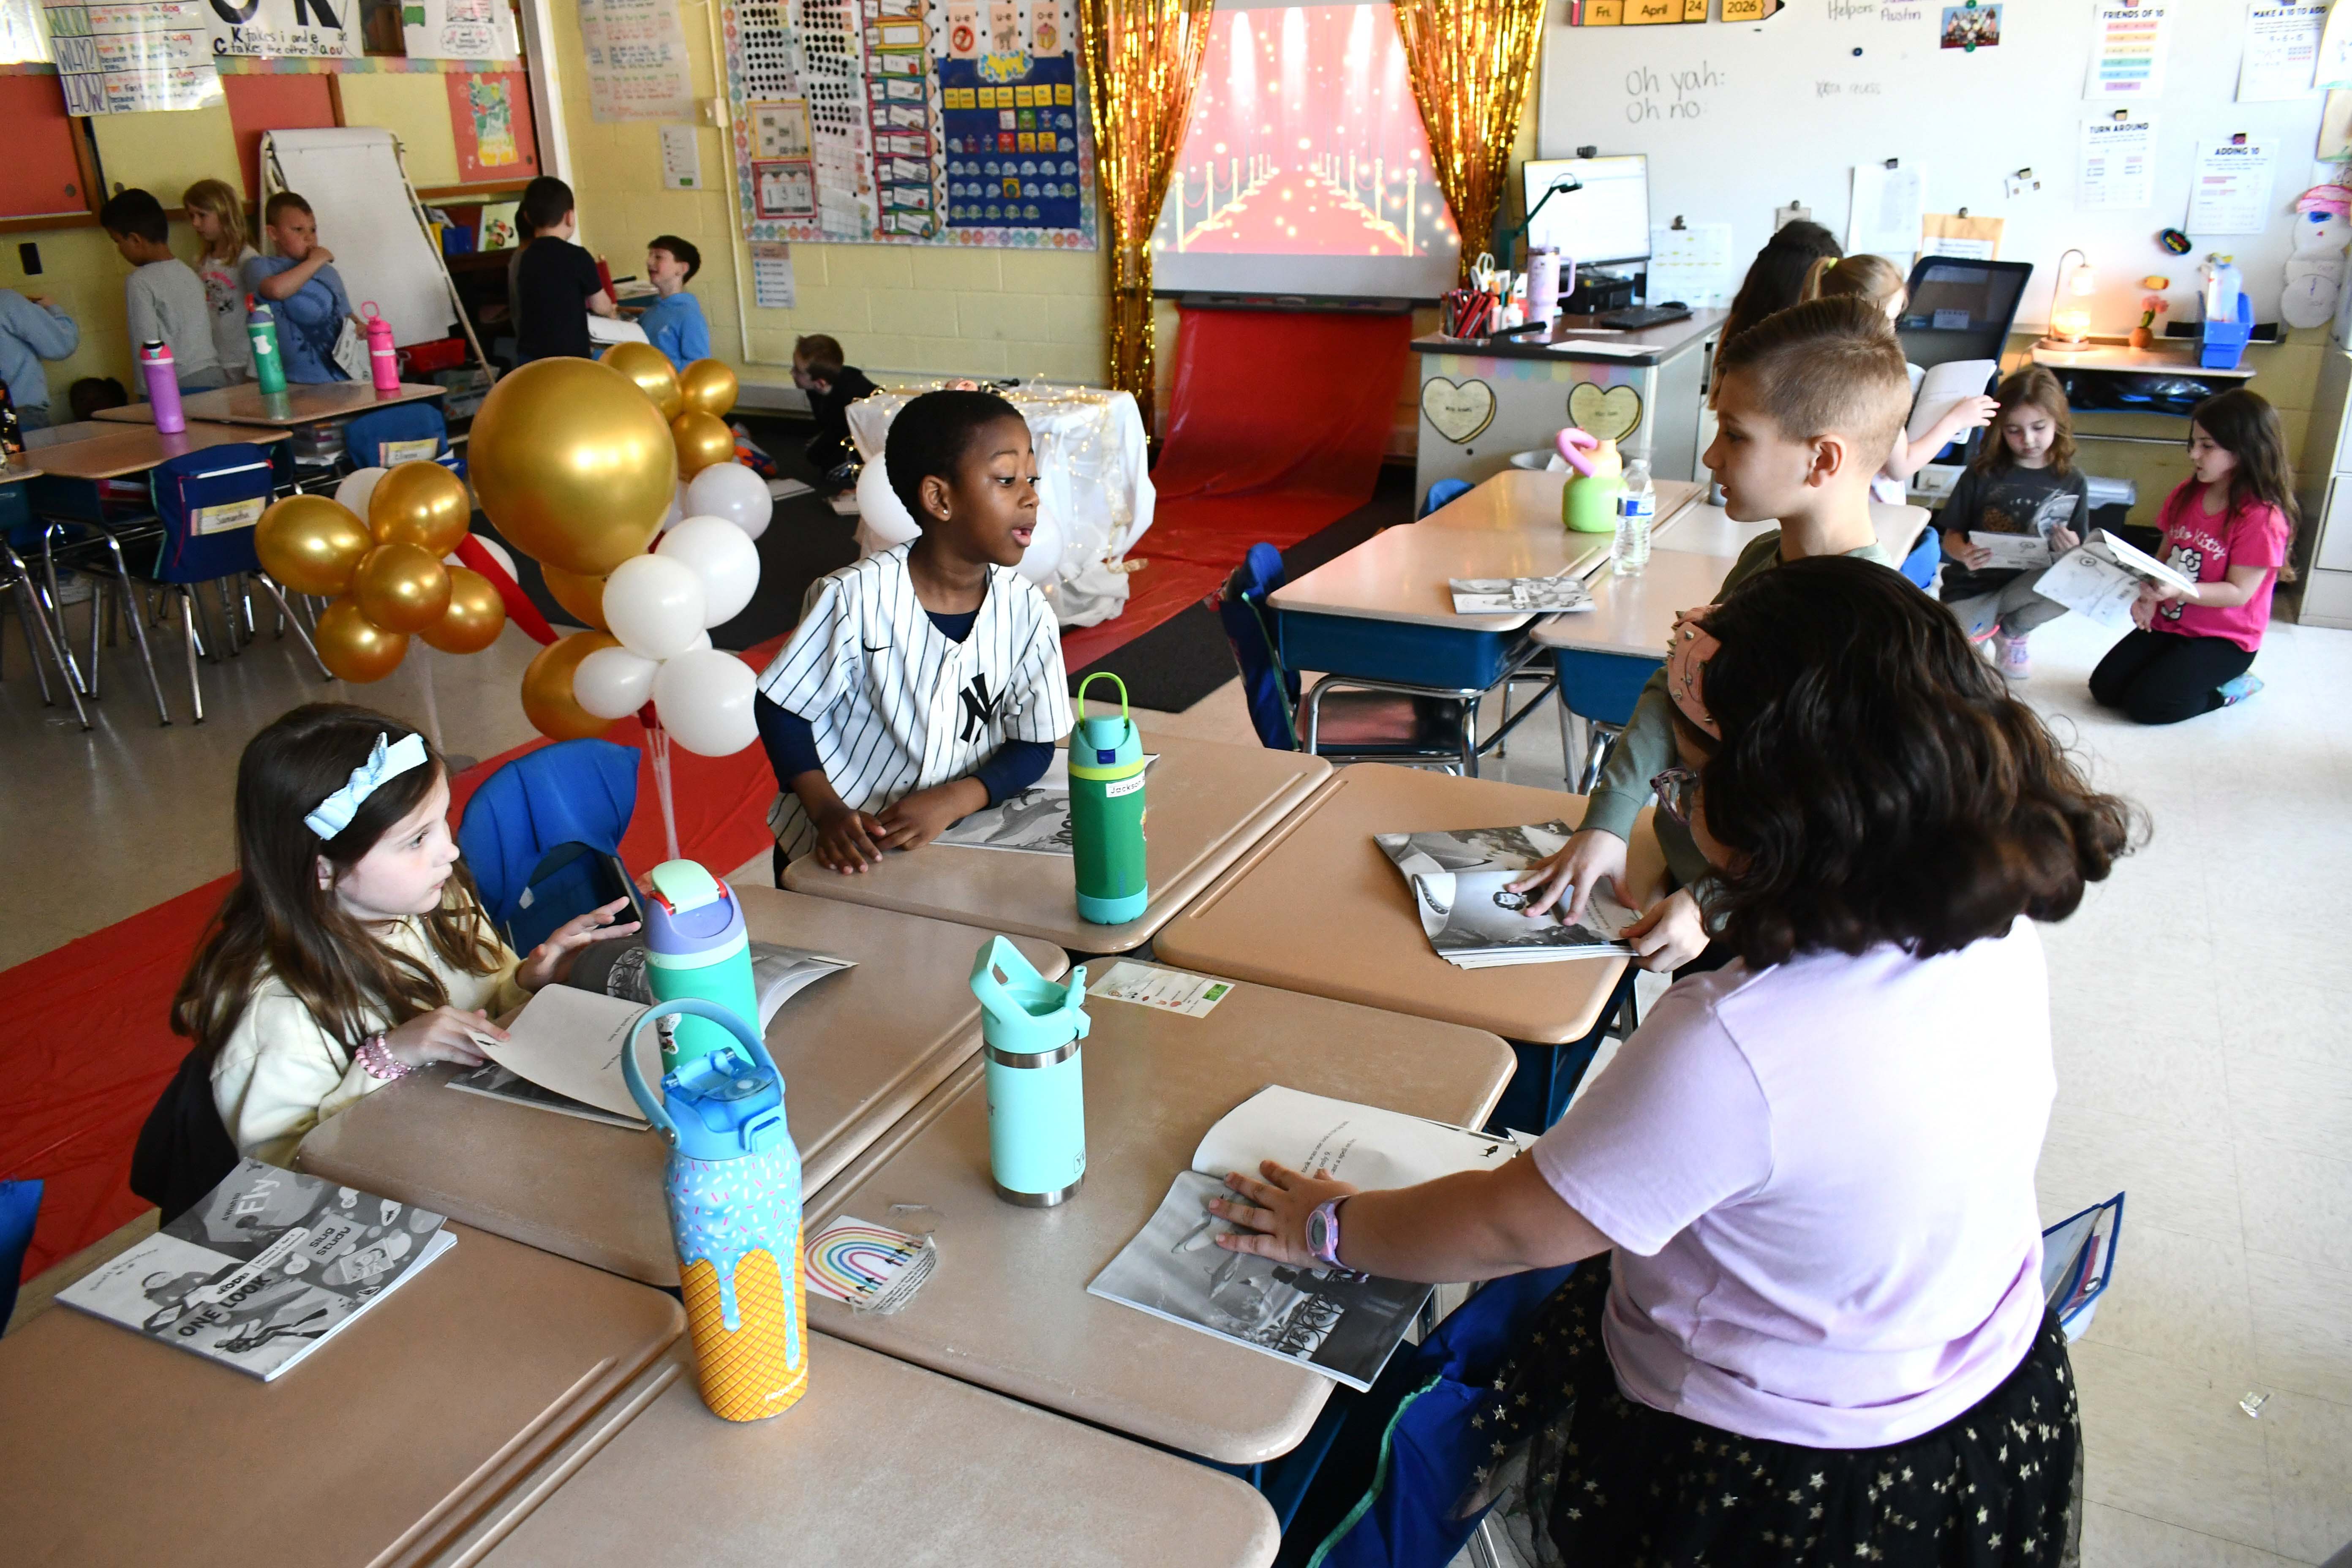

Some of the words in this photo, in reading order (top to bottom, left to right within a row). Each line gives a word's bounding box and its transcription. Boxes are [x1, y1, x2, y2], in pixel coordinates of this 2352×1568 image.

[1596, 6, 1611, 17] Fri.
[1641, 4, 1667, 16] April
[1687, 1, 1705, 12] 24.
[1727, 1, 1757, 14] 2026
[1881, 7, 1921, 22] Austin
[2103, 10, 2139, 19] FRIENDS
[2142, 9, 2153, 17] OF
[2156, 9, 2164, 17] 10
[2253, 9, 2276, 18] MAKE
[2309, 6, 2327, 14] ADD
[231, 26, 243, 43] K
[245, 28, 276, 43] takes
[280, 30, 285, 42] i
[291, 30, 308, 43] and
[311, 33, 319, 43] e
[214, 38, 227, 54] C
[231, 42, 261, 54] takes
[267, 44, 281, 53] the
[1626, 66, 1660, 96] Oh
[1670, 60, 1726, 101] yah:
[1626, 98, 1660, 123] Oh
[2090, 125, 2111, 133] TURN
[2113, 122, 2149, 132] AROUND
[2215, 147, 2248, 155] ADDING
[2251, 147, 2259, 155] 10
[2193, 528, 2226, 561] Kitty
[235, 1179, 280, 1214] Fly
[309, 1227, 336, 1248] Slug
[316, 1225, 352, 1257] Study
[177, 1309, 223, 1337] ONE
[219, 1274, 272, 1309] LOOK
